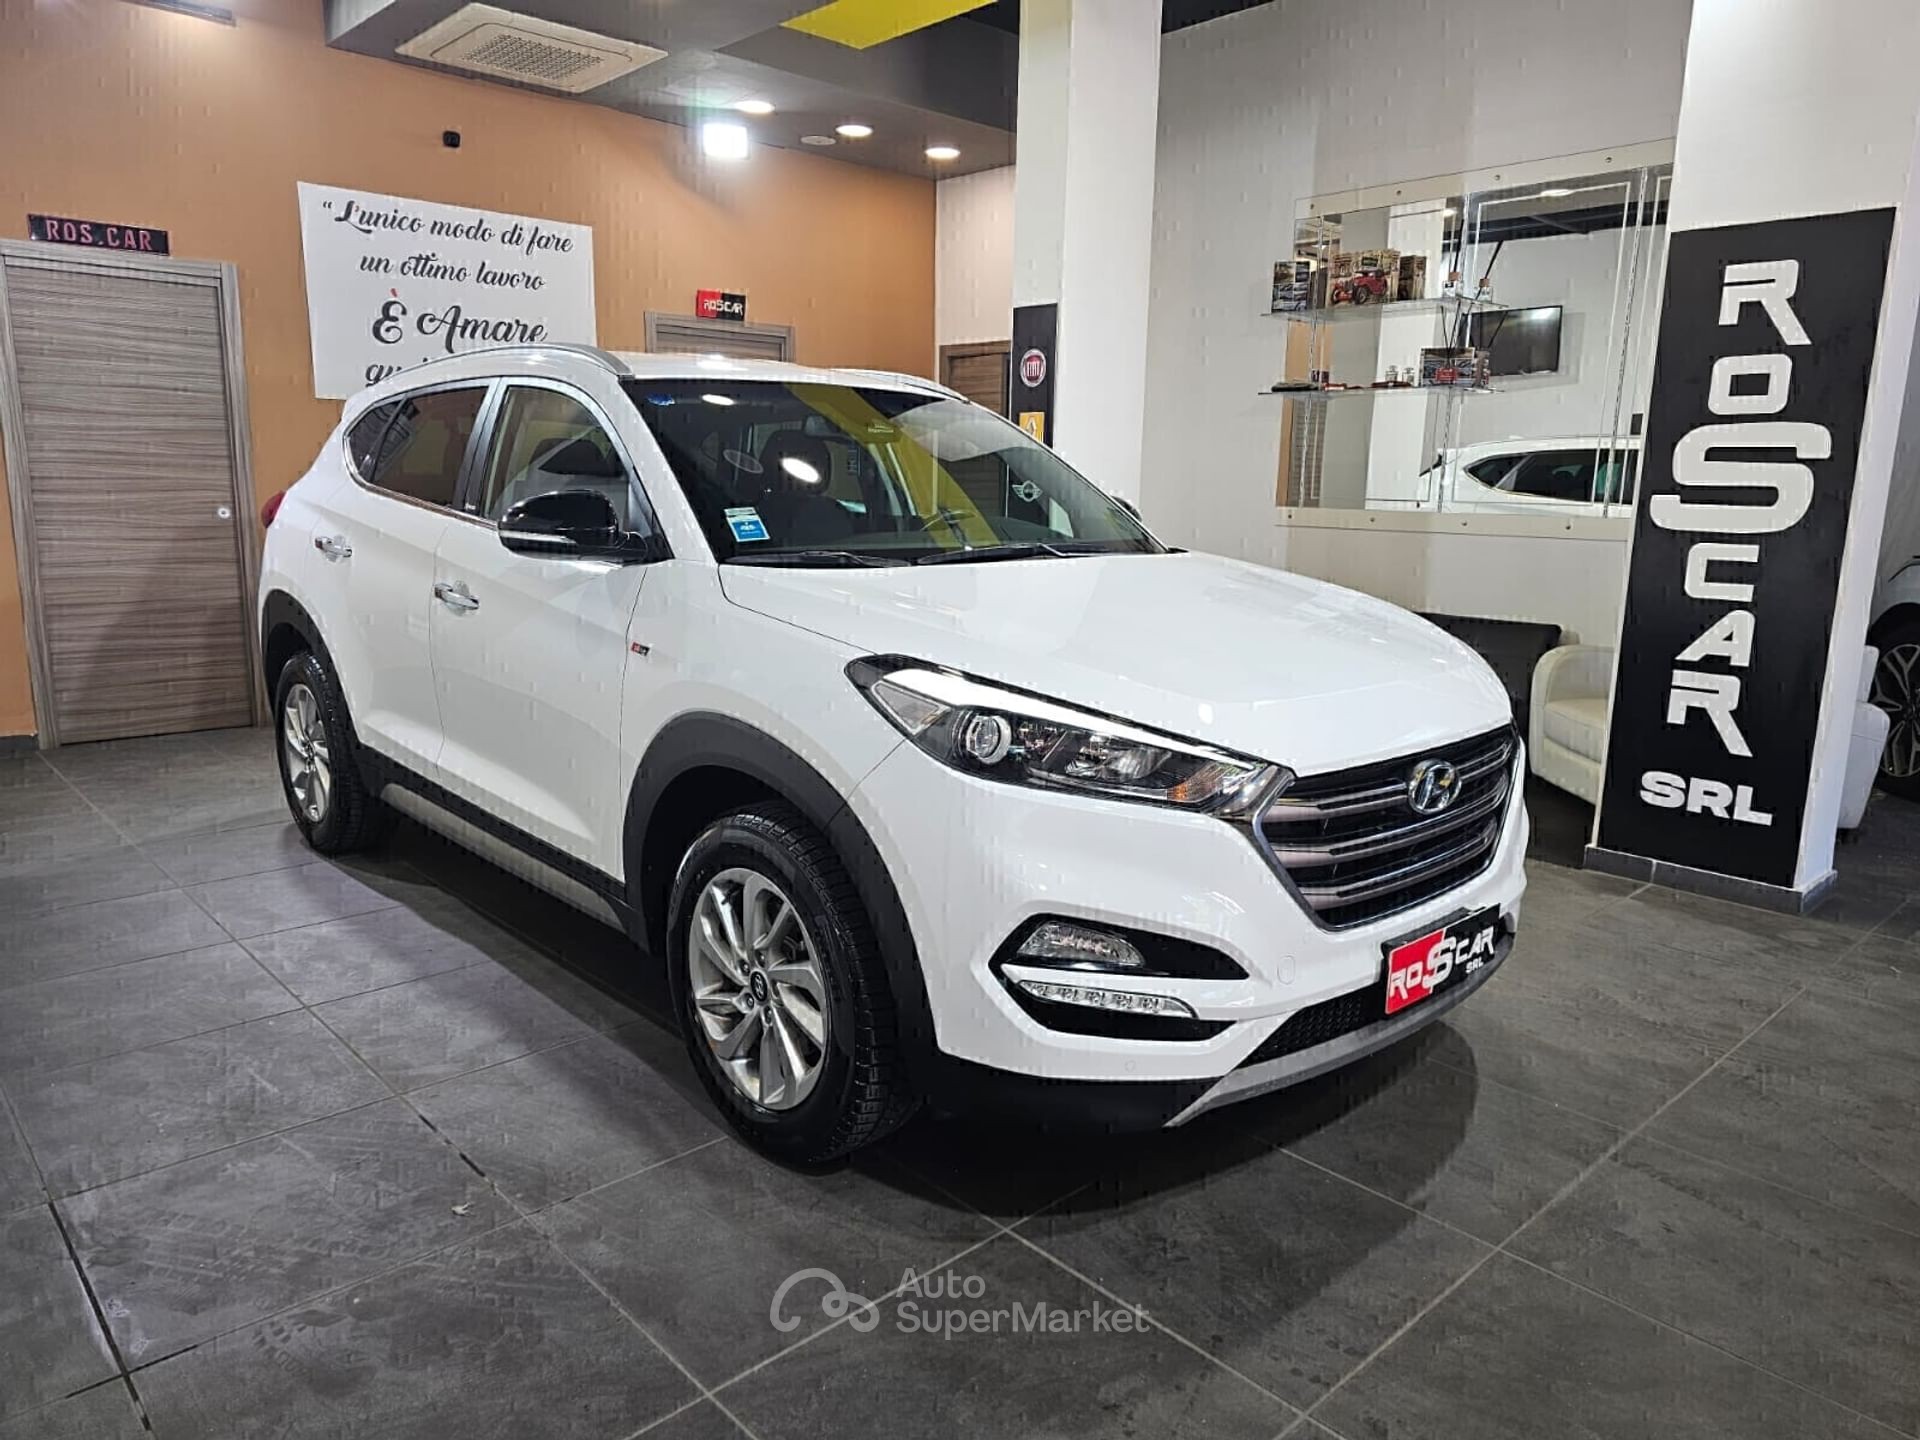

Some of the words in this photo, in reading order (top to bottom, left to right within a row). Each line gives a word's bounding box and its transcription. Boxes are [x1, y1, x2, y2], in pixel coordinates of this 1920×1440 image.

[46, 219, 153, 251] ROS.CAR
[430, 218, 496, 243] modo
[501, 223, 524, 247] di
[525, 226, 574, 256] fare
[360, 254, 394, 273] un
[400, 252, 471, 283] ottimo
[476, 261, 547, 292] lavoro
[372, 287, 408, 345] È
[416, 304, 549, 354] Amare
[1639, 770, 1773, 827] SRL
[1466, 956, 1485, 975] SRL
